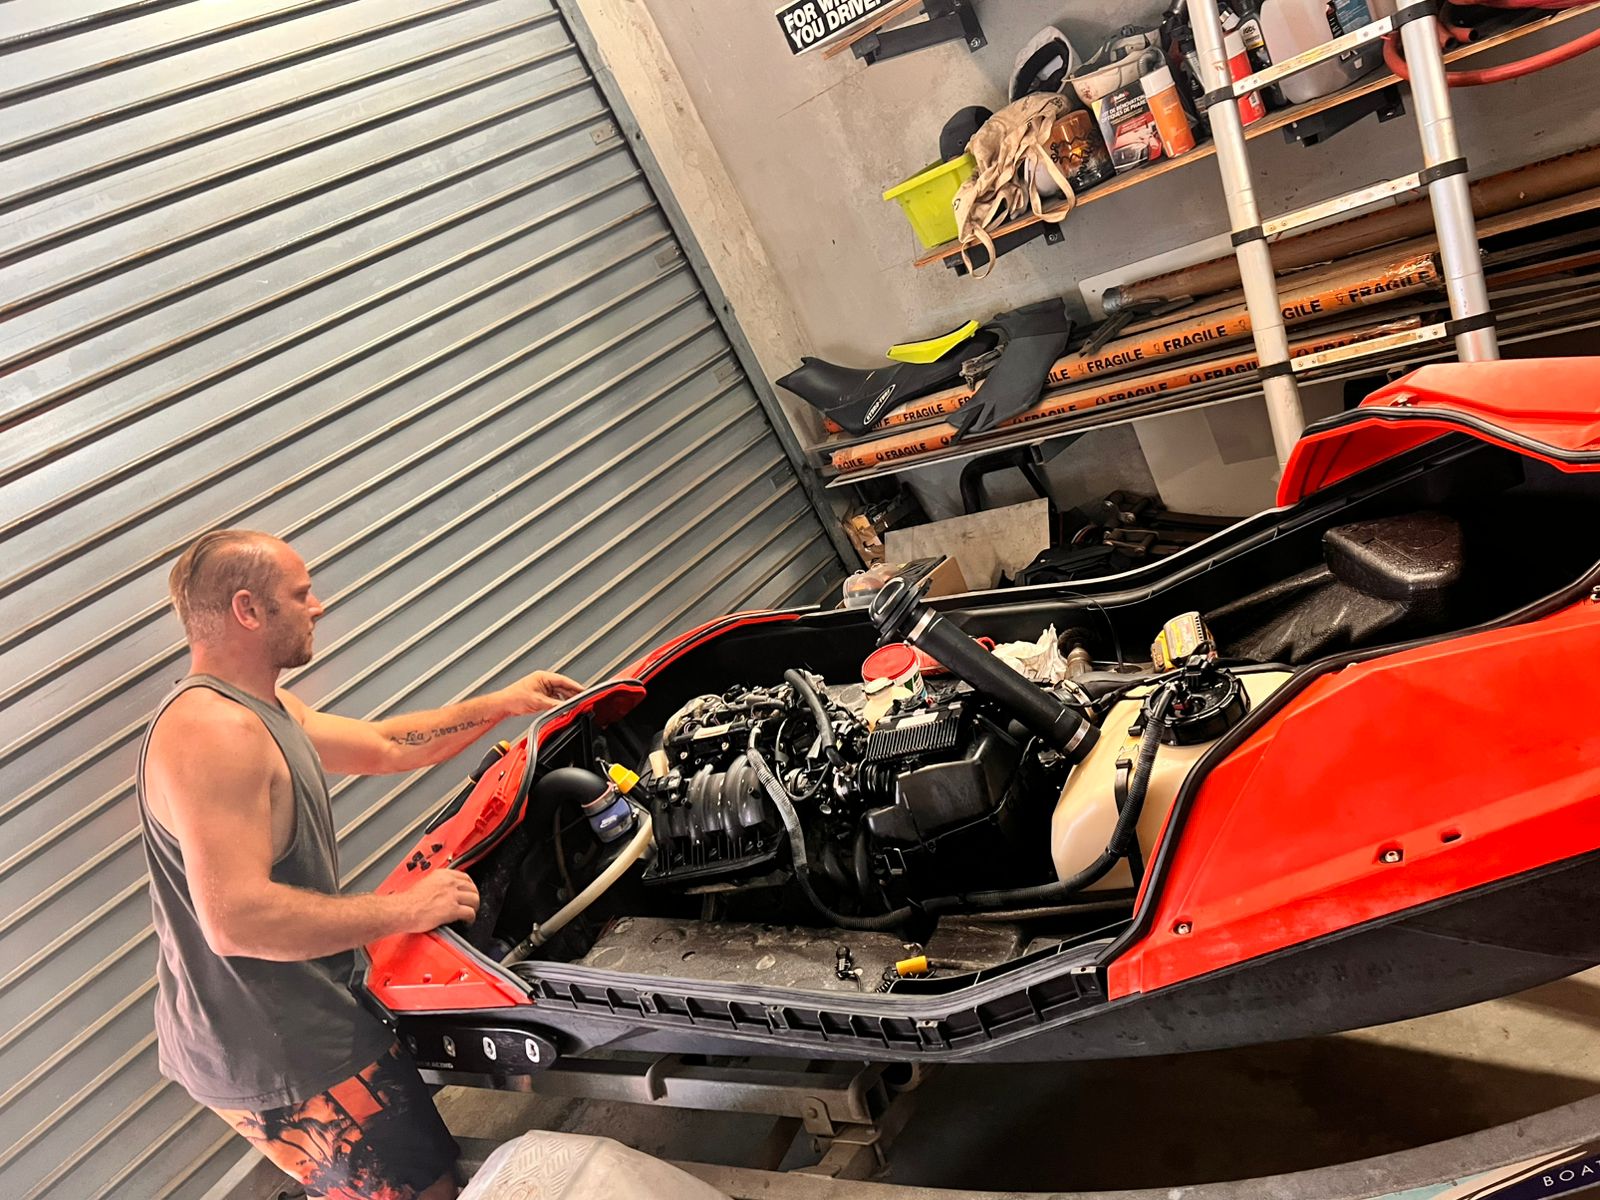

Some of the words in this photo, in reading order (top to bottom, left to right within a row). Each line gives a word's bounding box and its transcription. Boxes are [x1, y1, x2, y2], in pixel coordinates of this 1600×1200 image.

[784, 2, 818, 34] FOR
[790, 17, 825, 49] YOU
[1348, 270, 1431, 303] FRAGILE
[1281, 299, 1324, 320] GILE
[1163, 325, 1228, 352] FRAGILE
[1087, 348, 1145, 373] FRAGILE
[903, 403, 945, 421] FRAGILE
[885, 443, 928, 460] FRAGILE
